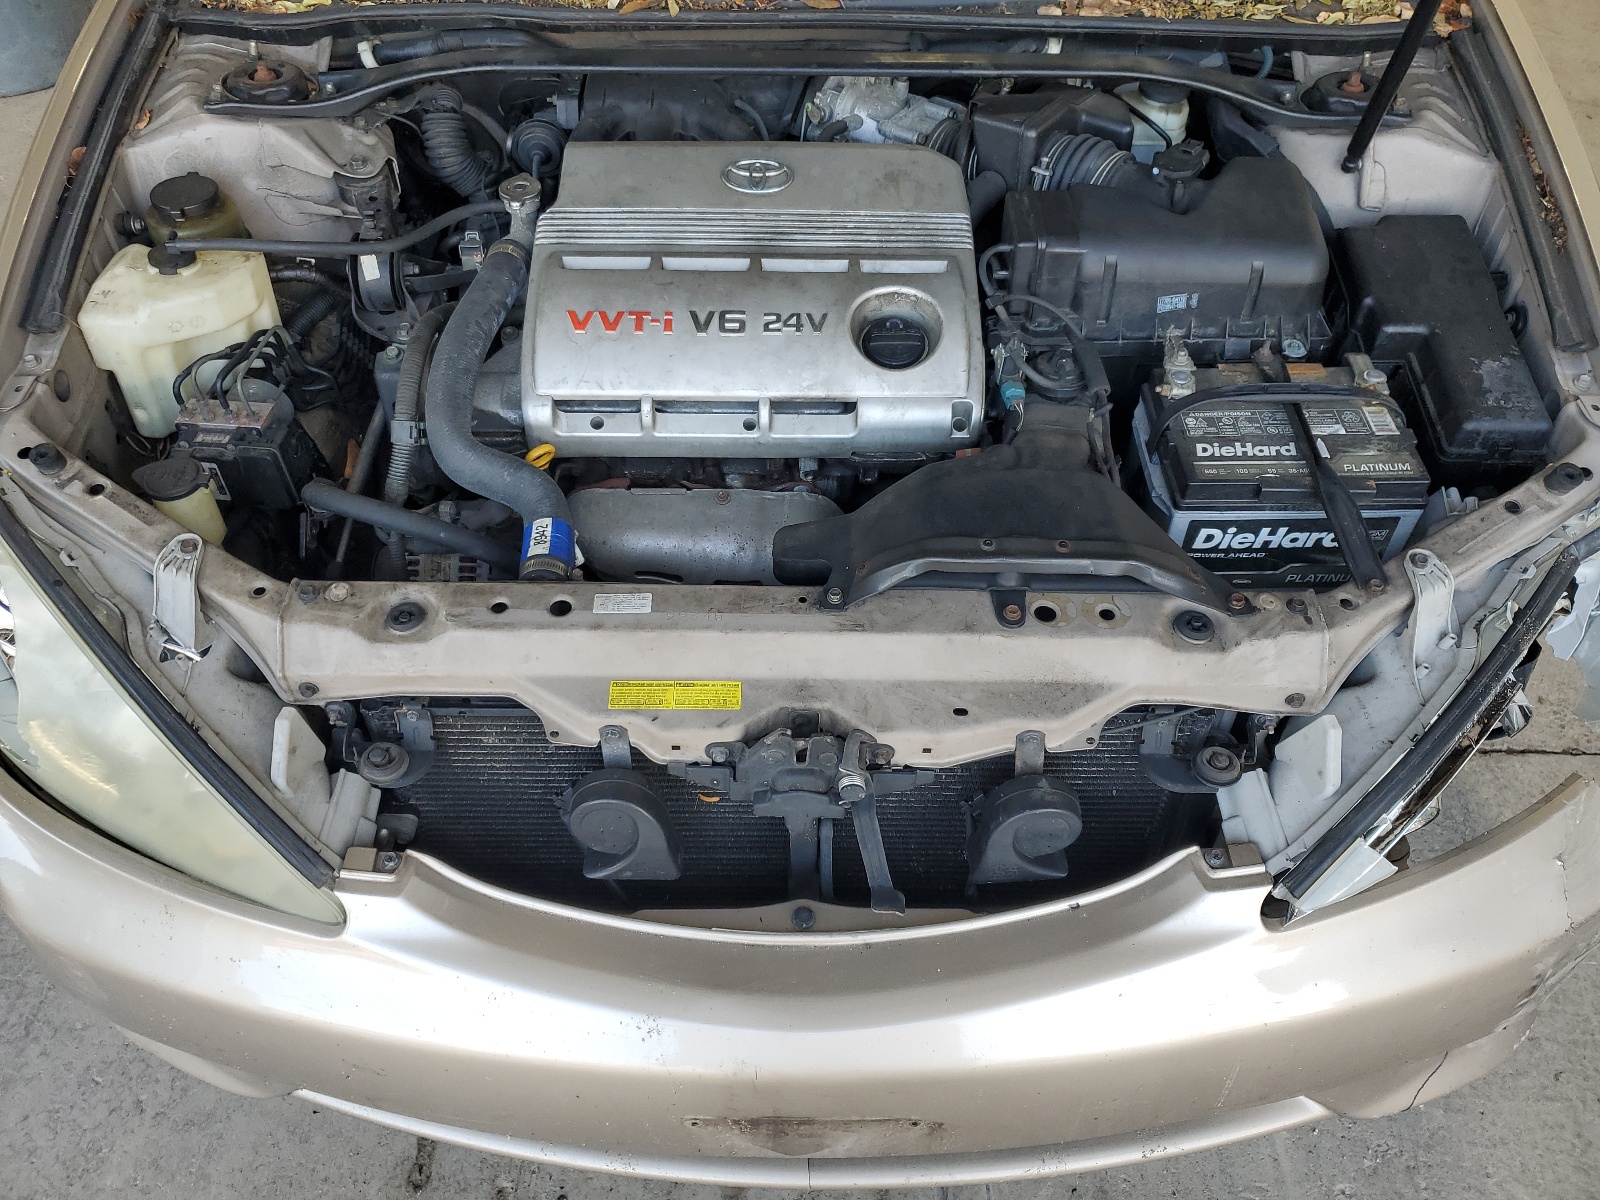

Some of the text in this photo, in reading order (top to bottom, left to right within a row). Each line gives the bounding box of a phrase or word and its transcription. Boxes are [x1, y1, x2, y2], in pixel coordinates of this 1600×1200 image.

[567, 310, 829, 337] VVT-i V6 24V
[1195, 442, 1298, 457] DieHard
[1343, 462, 1412, 472] PLATINUM
[534, 523, 549, 547] 8942
[1285, 573, 1352, 583] PLATINU
